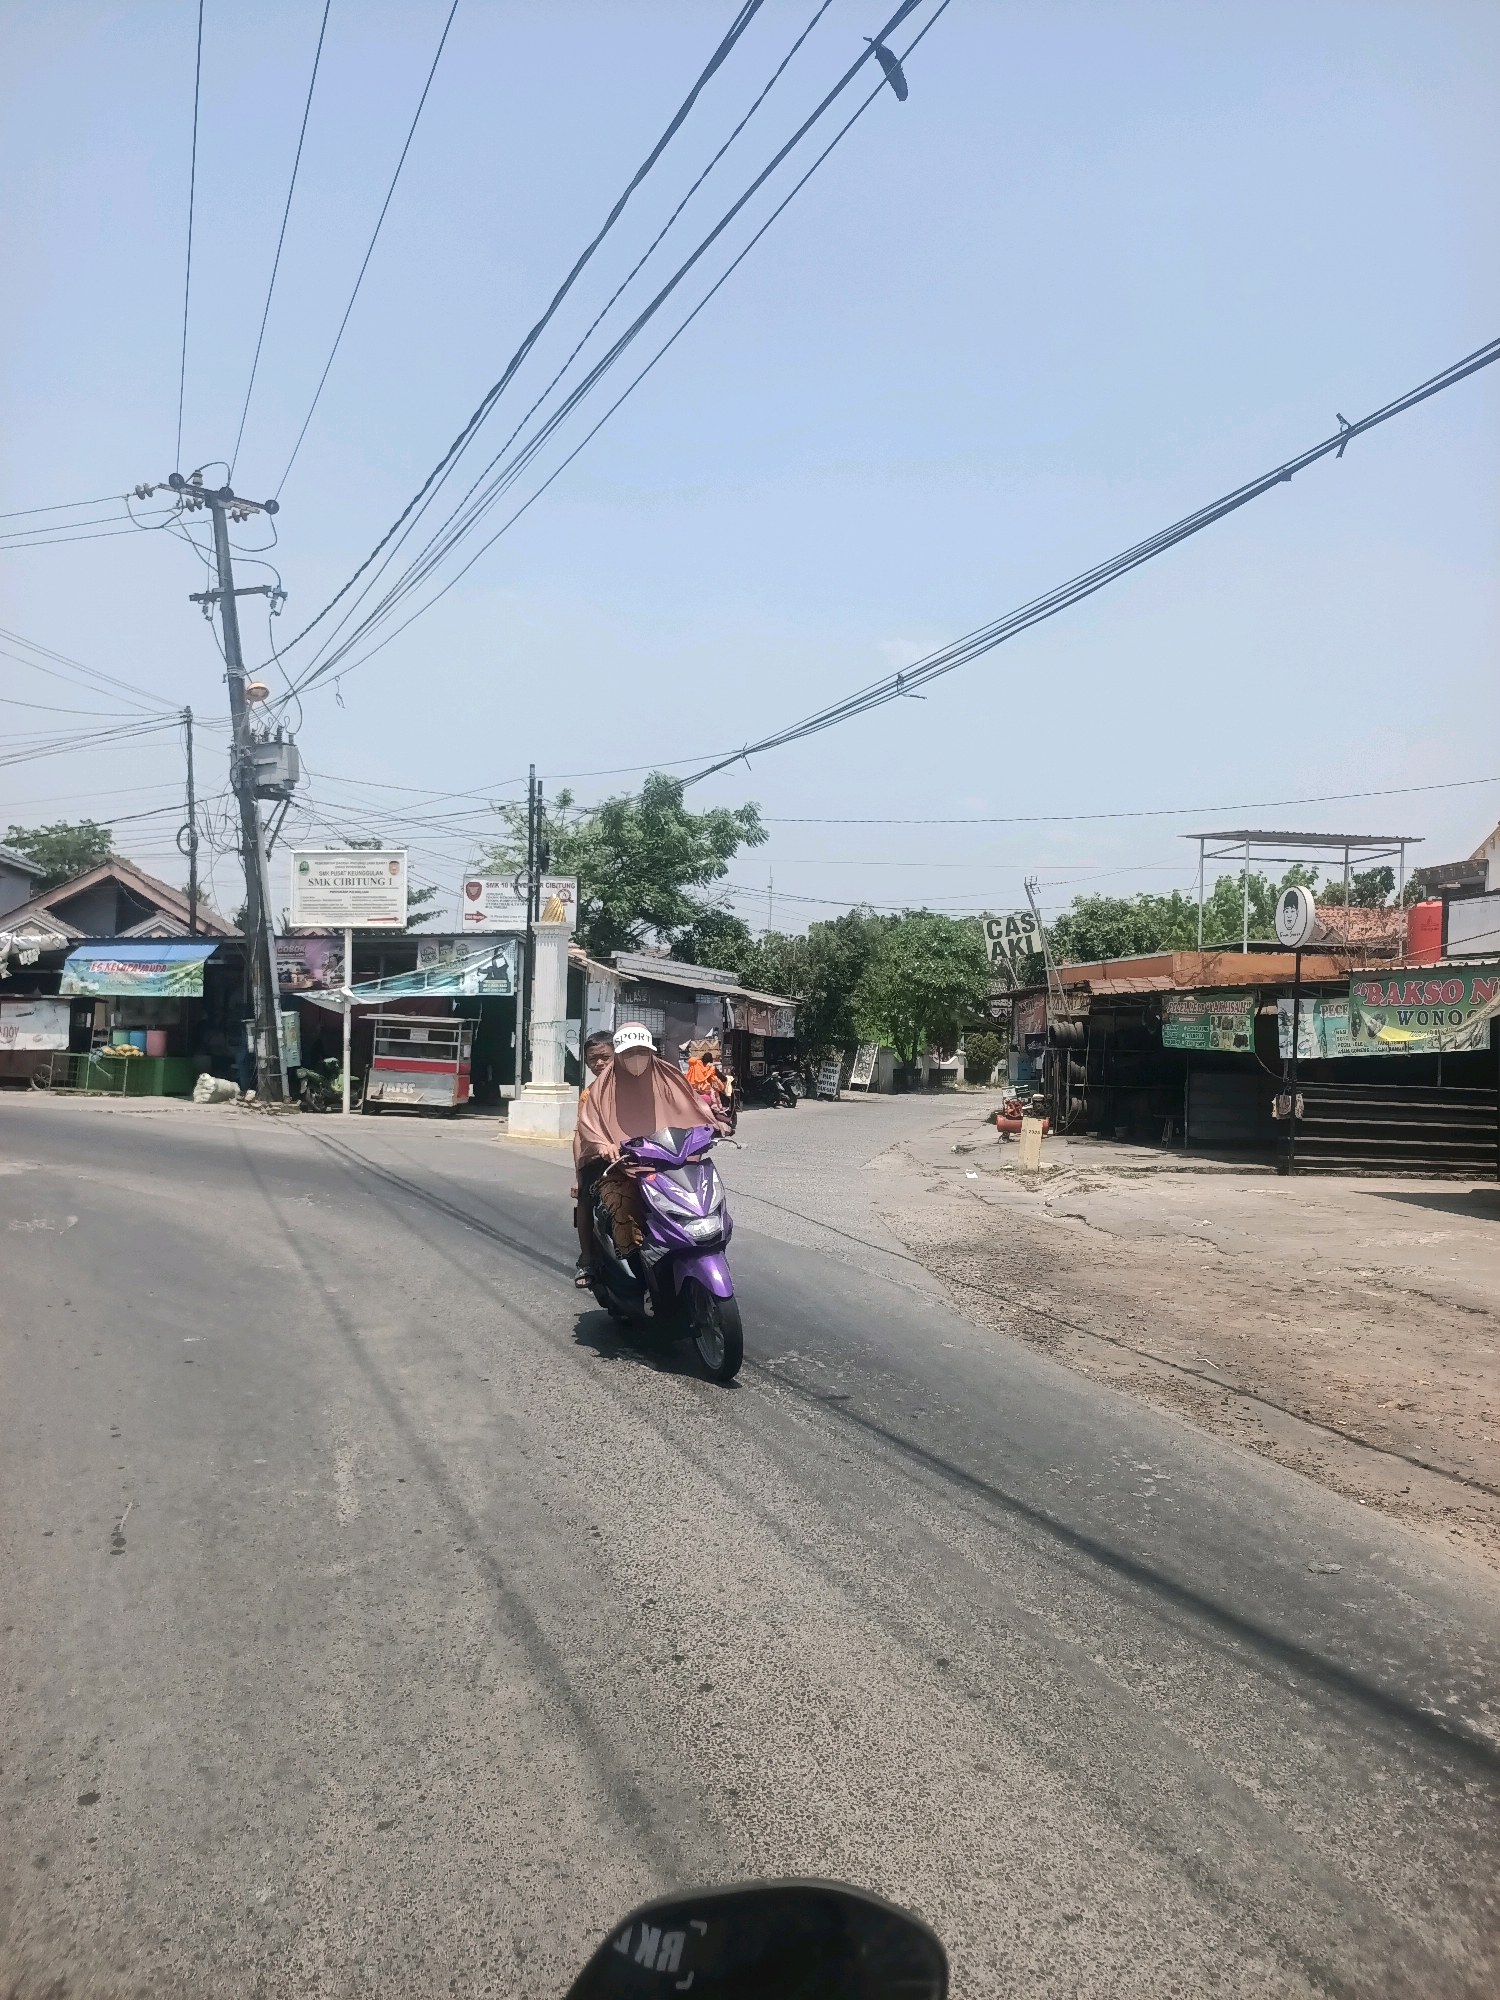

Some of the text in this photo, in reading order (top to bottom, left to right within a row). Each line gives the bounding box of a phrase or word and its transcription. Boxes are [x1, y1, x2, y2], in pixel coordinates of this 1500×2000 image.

[308, 877, 393, 886] SMK CIBITUNG 1
[986, 912, 1036, 940] CAS
[991, 935, 1034, 960] AKI
[1469, 977, 1500, 1005] N
[614, 1032, 652, 1046] SPORT
